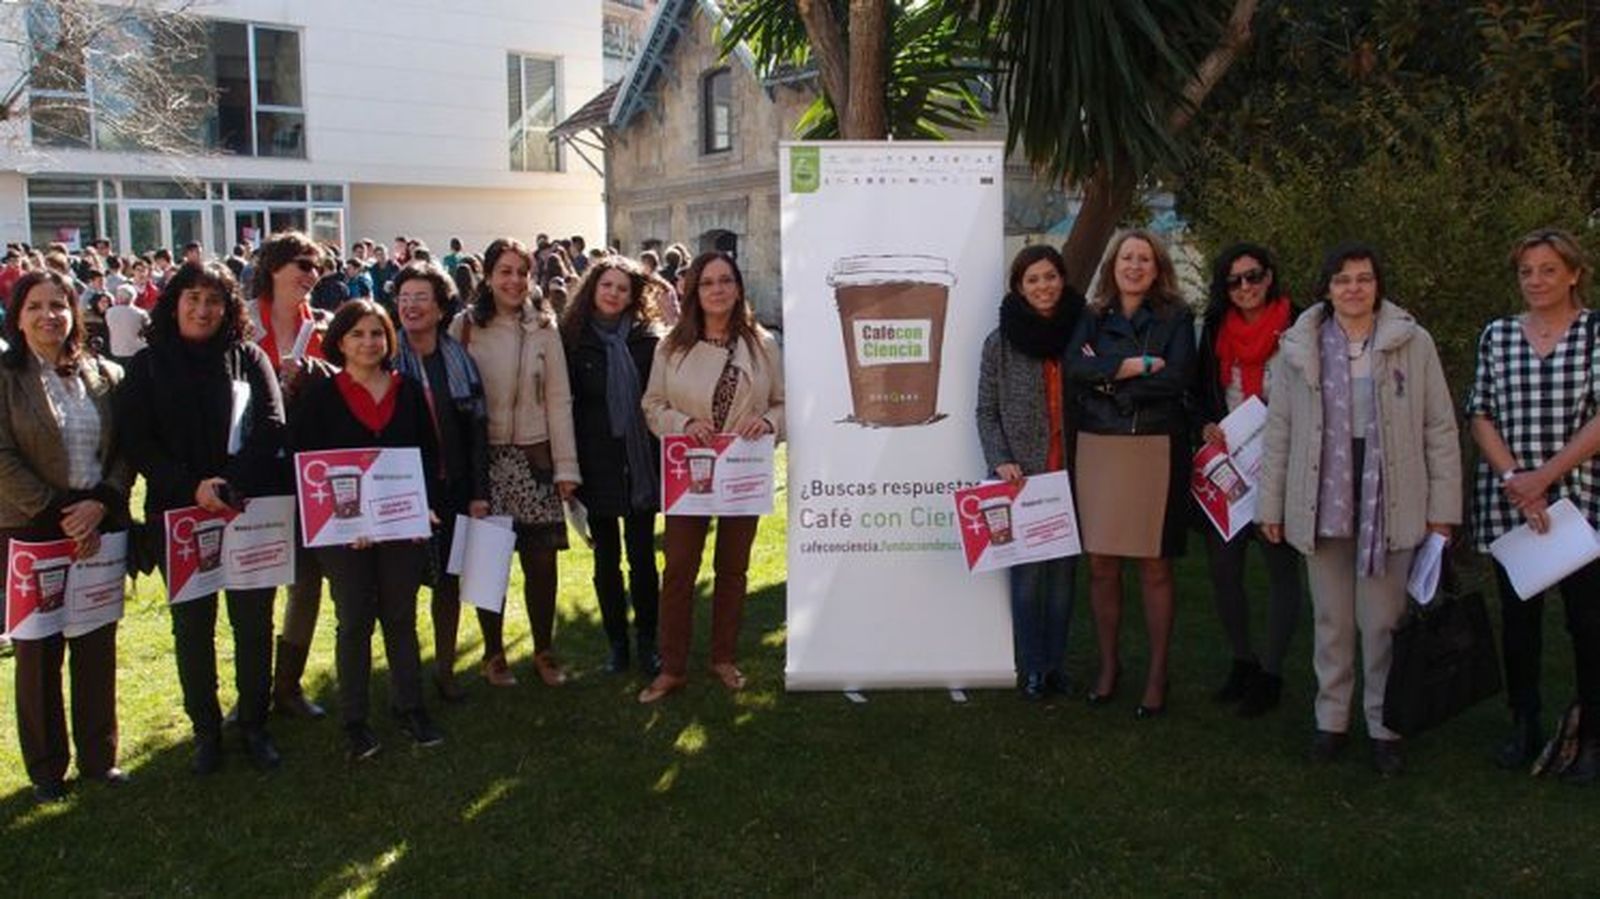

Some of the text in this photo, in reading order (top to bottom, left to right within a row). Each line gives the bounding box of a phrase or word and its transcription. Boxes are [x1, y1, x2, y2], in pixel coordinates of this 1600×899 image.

[862, 341, 923, 358] Ciencia
[801, 479, 877, 500] ¿Buscas
[800, 507, 852, 529] Café
[861, 511, 902, 529] con
